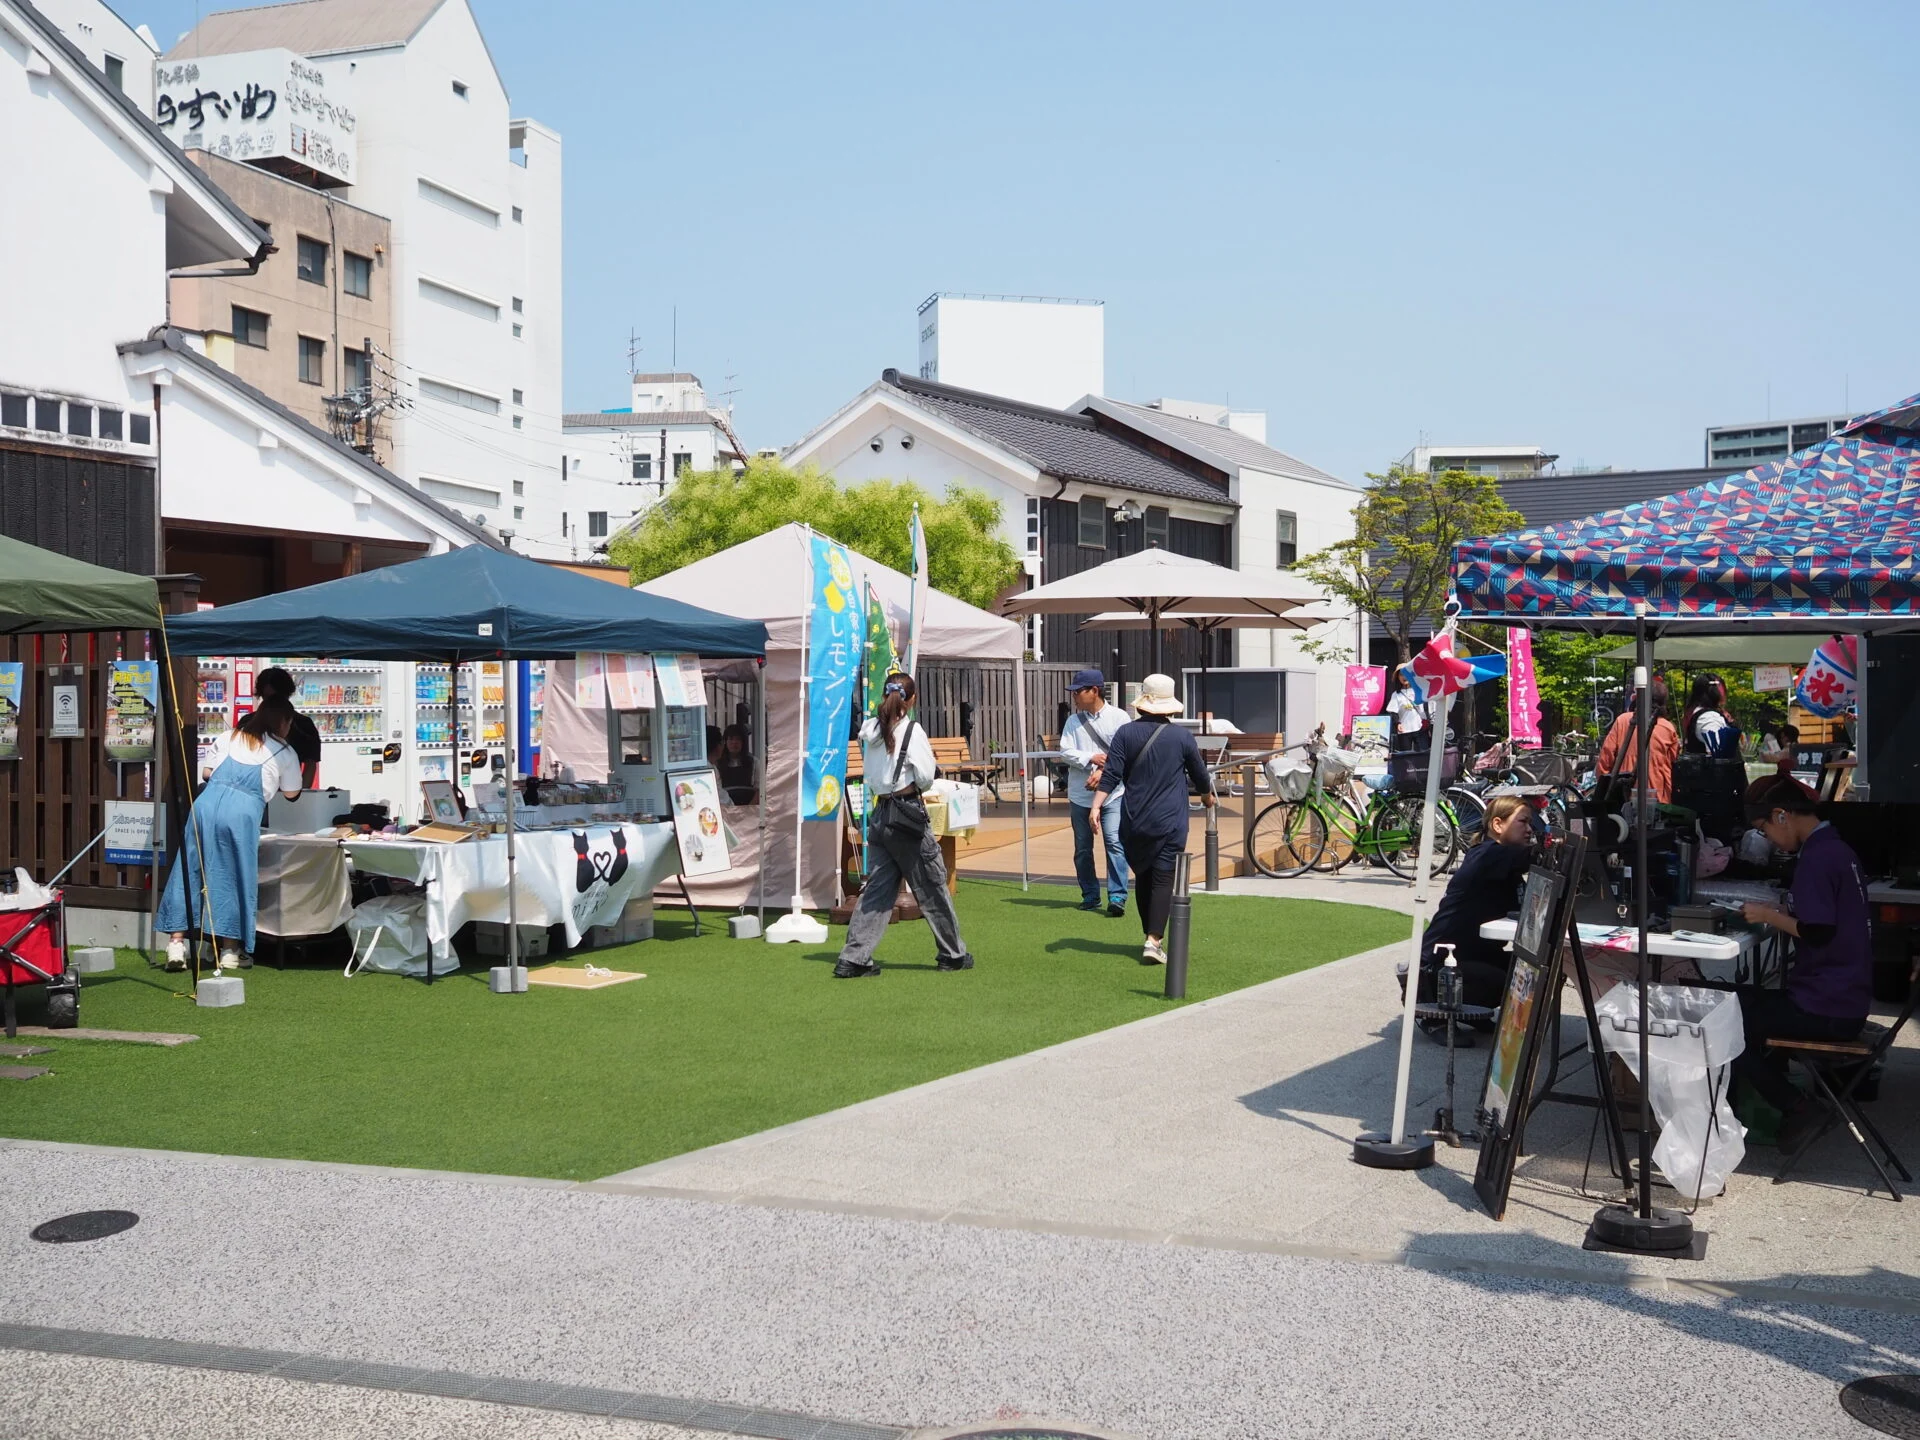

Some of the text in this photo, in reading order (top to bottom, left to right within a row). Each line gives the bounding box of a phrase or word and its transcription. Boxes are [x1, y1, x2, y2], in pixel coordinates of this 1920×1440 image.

[1515, 648, 1531, 734] スタンプラリー
